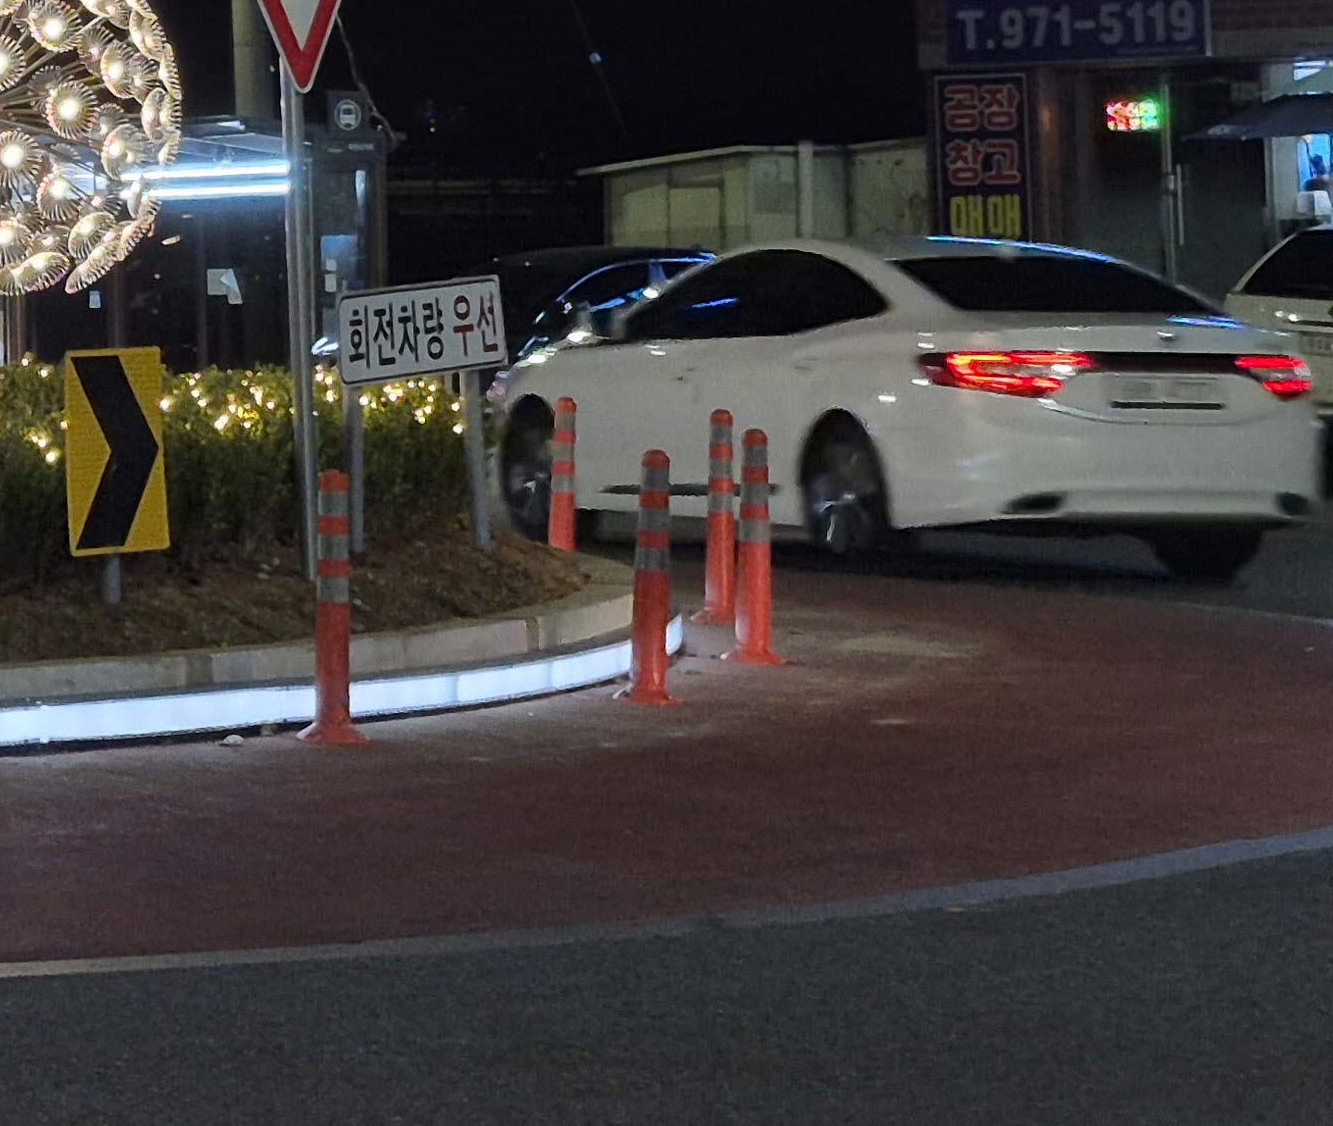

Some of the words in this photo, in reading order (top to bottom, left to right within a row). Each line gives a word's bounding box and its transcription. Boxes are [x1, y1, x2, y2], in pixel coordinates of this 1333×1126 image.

[956, 0, 1196, 50] T.971-5119
[943, 84, 1021, 132] 공장
[945, 139, 1021, 186] 창고
[950, 194, 1022, 238] 매매
[349, 296, 445, 369] 회전차량
[453, 290, 499, 357] 우선
